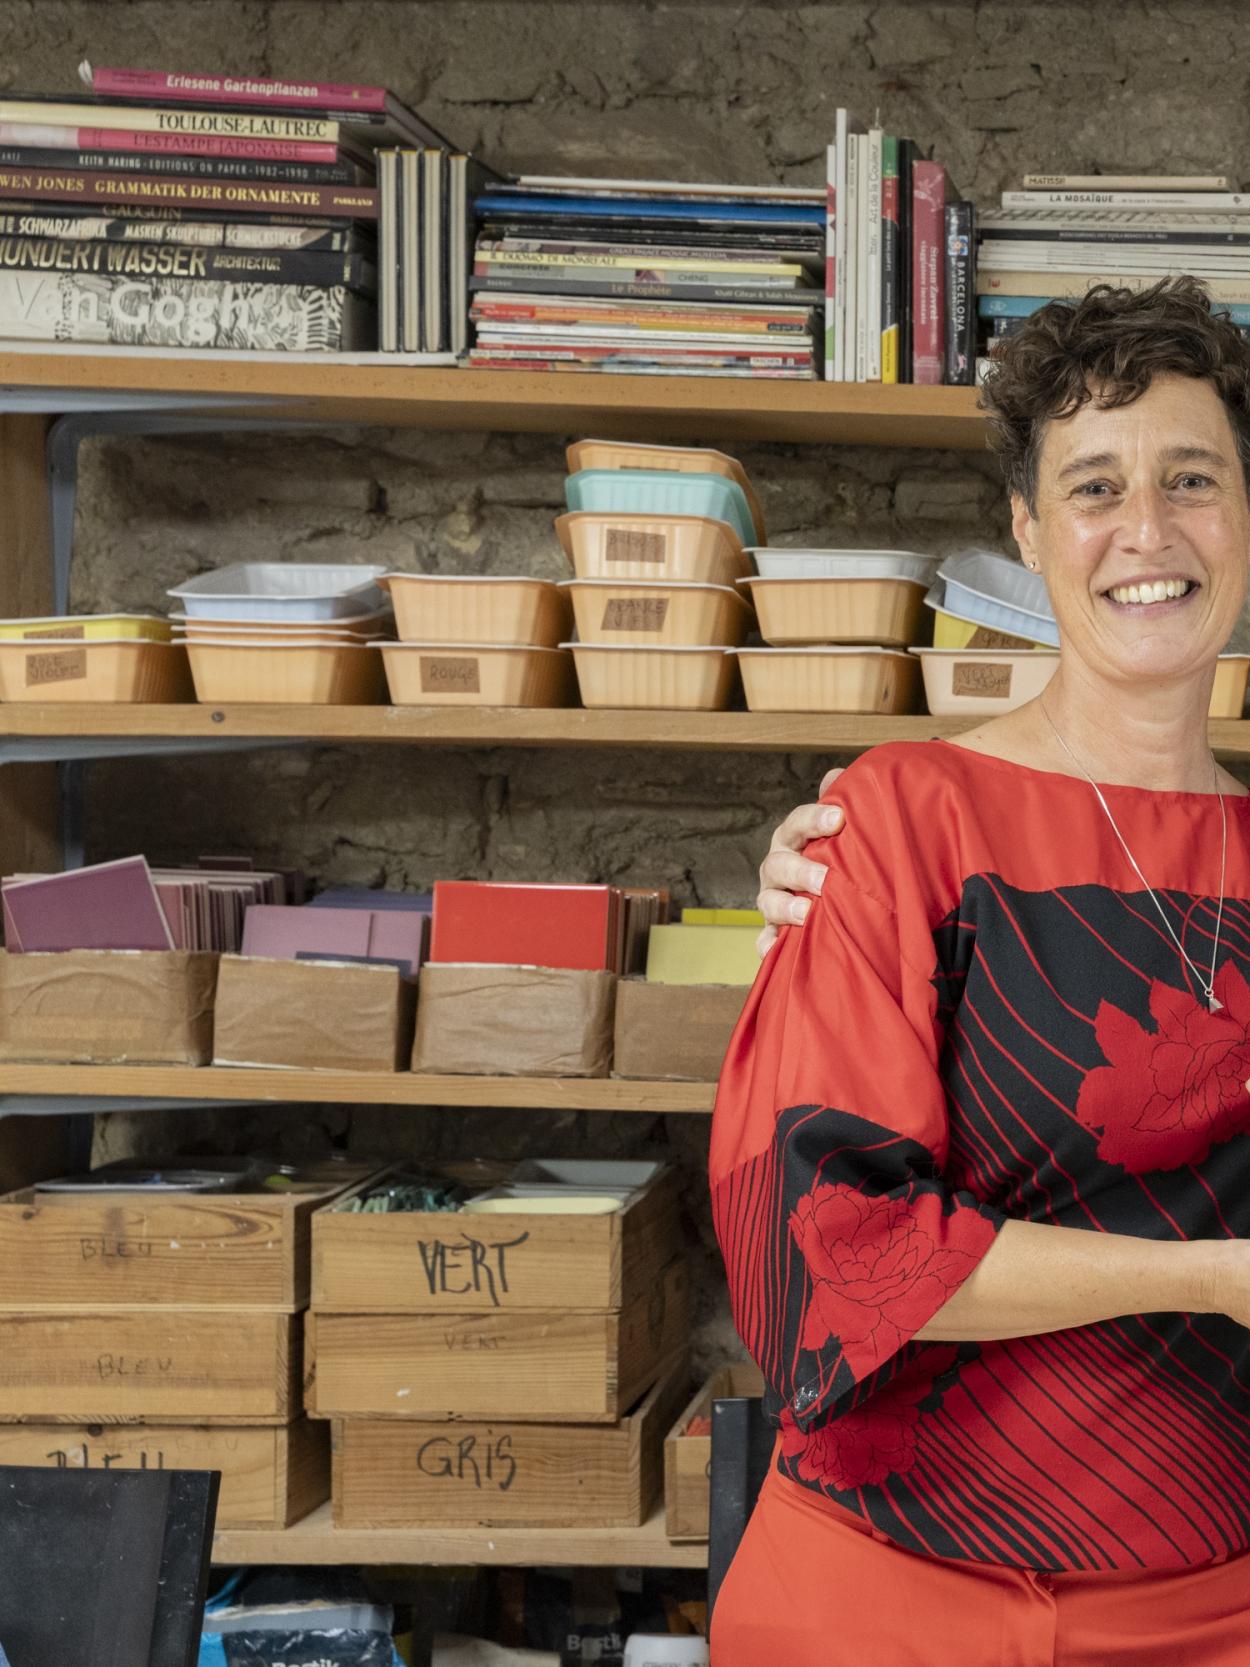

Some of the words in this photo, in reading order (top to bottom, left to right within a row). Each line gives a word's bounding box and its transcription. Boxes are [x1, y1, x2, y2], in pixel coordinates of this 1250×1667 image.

[166, 74, 220, 91] Erlesene
[223, 78, 319, 98] Gartenpflanzen
[156, 113, 327, 138] TOULOUSE-LAUTREC
[218, 138, 303, 157] JAPONAISE
[79, 155, 104, 166] KEITH
[108, 157, 141, 169] HARING
[150, 159, 195, 172] EDITIONS
[199, 162, 212, 173] ON
[218, 164, 247, 175] PAPER
[0, 174, 31, 188] WEN
[36, 177, 85, 192] JONES
[95, 181, 187, 198] GRAMMATIK
[191, 185, 222, 199] DER
[225, 187, 321, 206] ORNAMENTE
[1049, 194, 1062, 203] LA
[1064, 193, 1115, 203] MOSAÏQUE
[103, 205, 182, 219] GAUGUIN
[19, 217, 107, 238] SCHWARZAFRIKA
[124, 225, 162, 240] MASKEN
[0, 240, 206, 277] UNDERTWASSER
[502, 253, 545, 262] DUOMO
[562, 257, 617, 265] MONREALE
[612, 285, 624, 293] Le
[956, 261, 966, 332] BARCELONA
[111, 281, 250, 346] Gogh
[80, 1238, 152, 1262] BLEU
[416, 1231, 530, 1307] VERT
[443, 1332, 508, 1351] VERT
[96, 1353, 173, 1380] BLEU
[416, 1428, 517, 1491] GRIS
